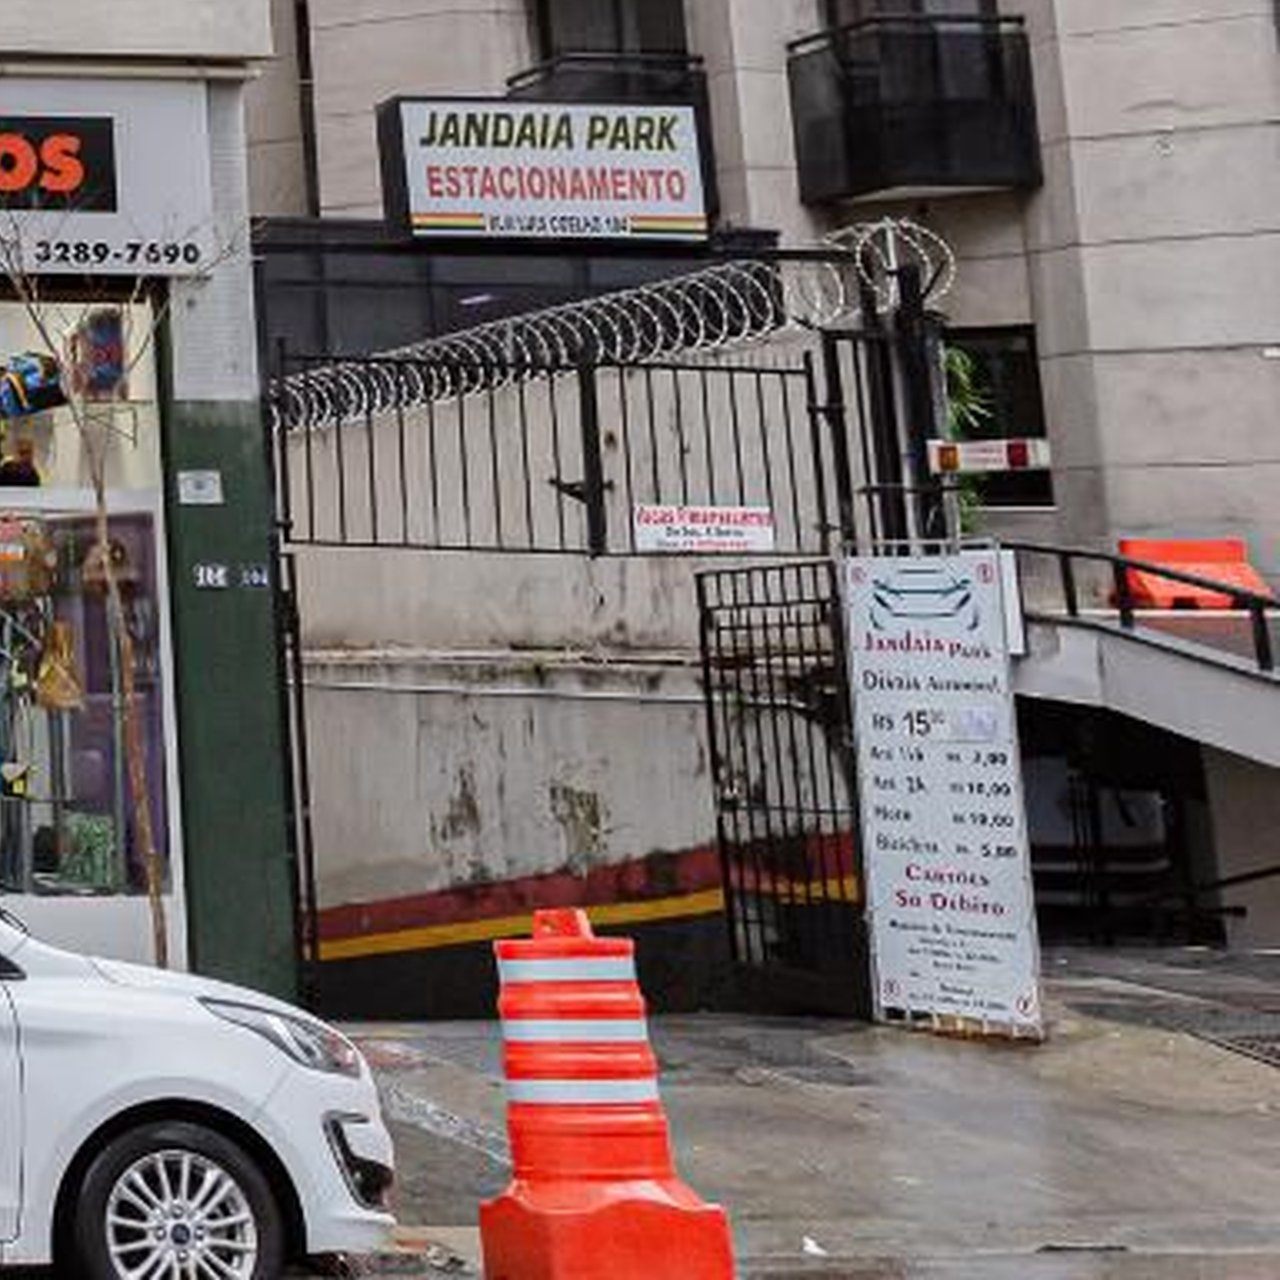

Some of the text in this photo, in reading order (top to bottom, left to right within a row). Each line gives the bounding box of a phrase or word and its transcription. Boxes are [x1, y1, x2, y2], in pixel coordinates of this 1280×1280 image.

[419, 113, 678, 151] JANDAIA PARK
[426, 165, 686, 202] ESTACIONAMENTO
[34, 241, 201, 265] 3289-7690
